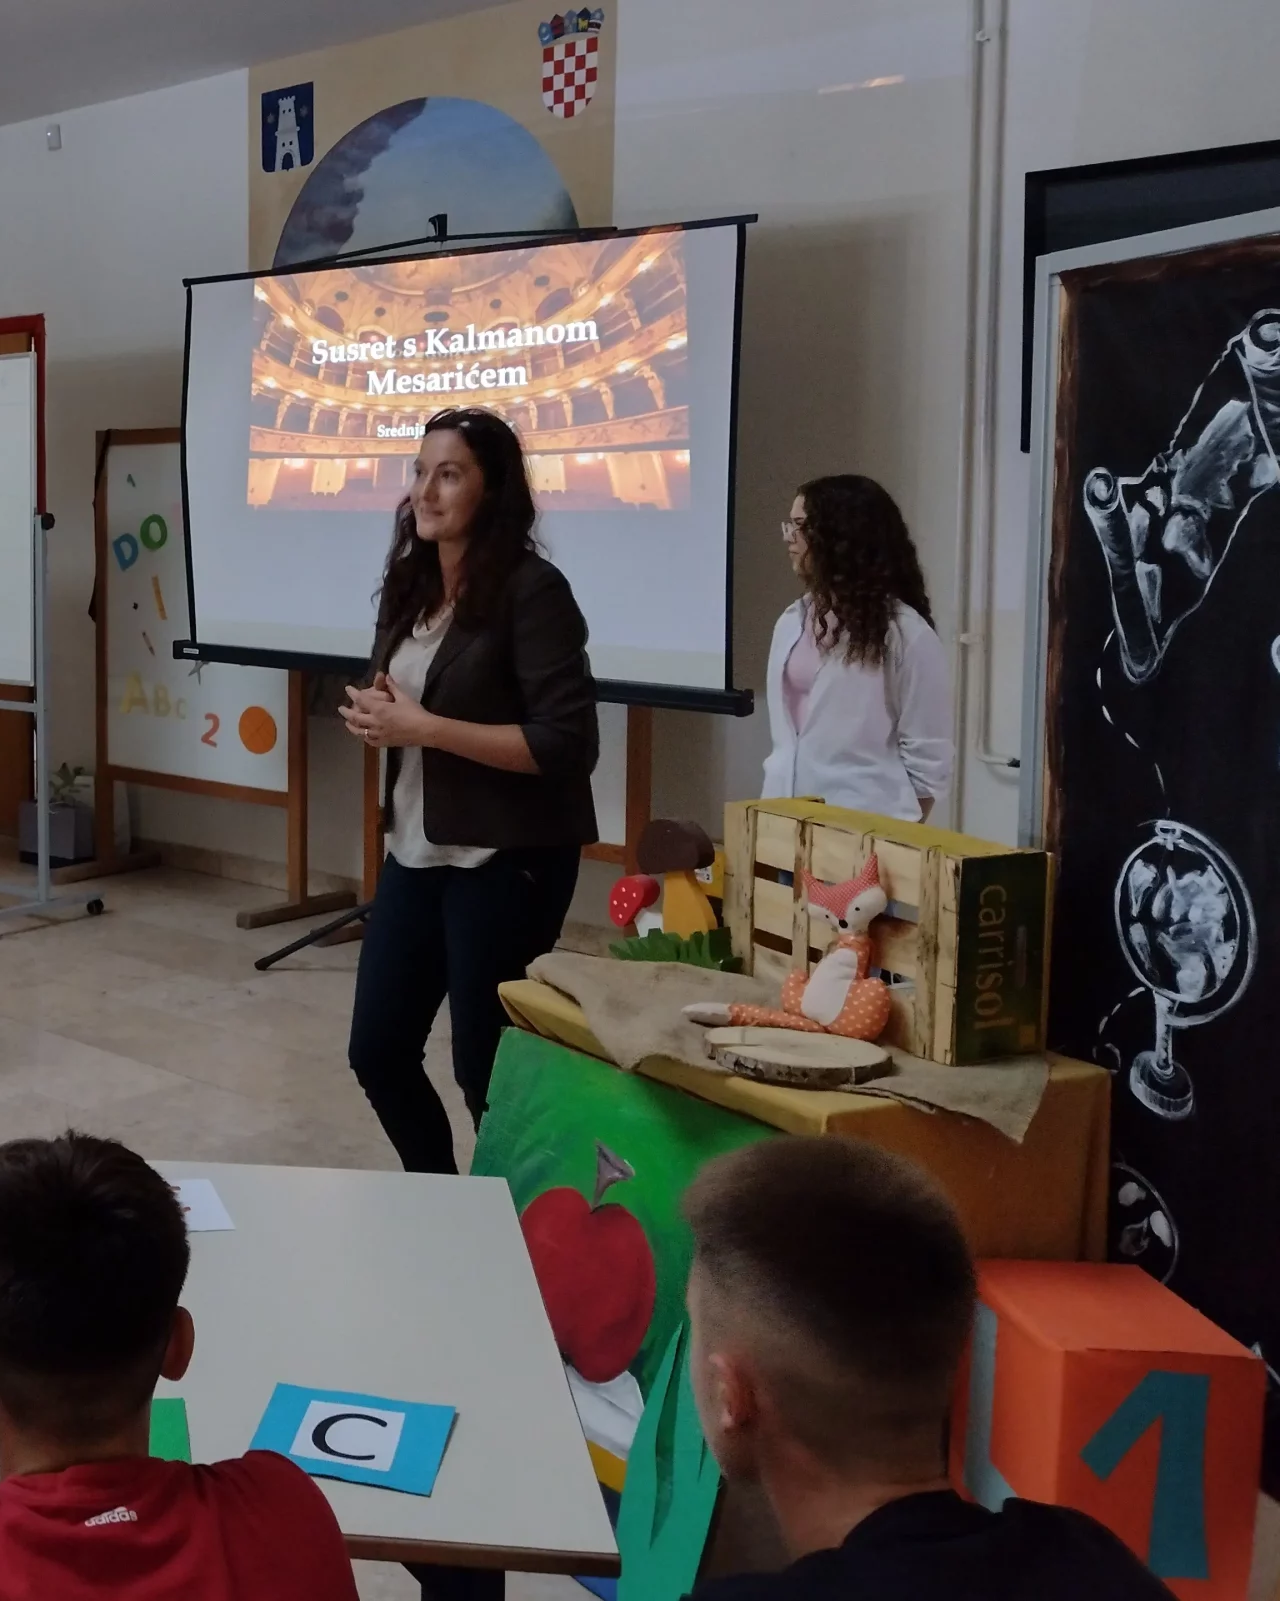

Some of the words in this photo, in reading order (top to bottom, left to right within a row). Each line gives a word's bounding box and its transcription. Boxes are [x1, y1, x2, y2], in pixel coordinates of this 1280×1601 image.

[311, 333, 397, 366] Susret
[403, 335, 417, 357] s
[424, 319, 599, 356] Kalmanom
[366, 361, 528, 397] Mesarićem
[201, 712, 220, 748] 2
[974, 884, 1015, 1031] carrisol
[311, 1413, 387, 1461] C
[1079, 1370, 1211, 1580] 1
